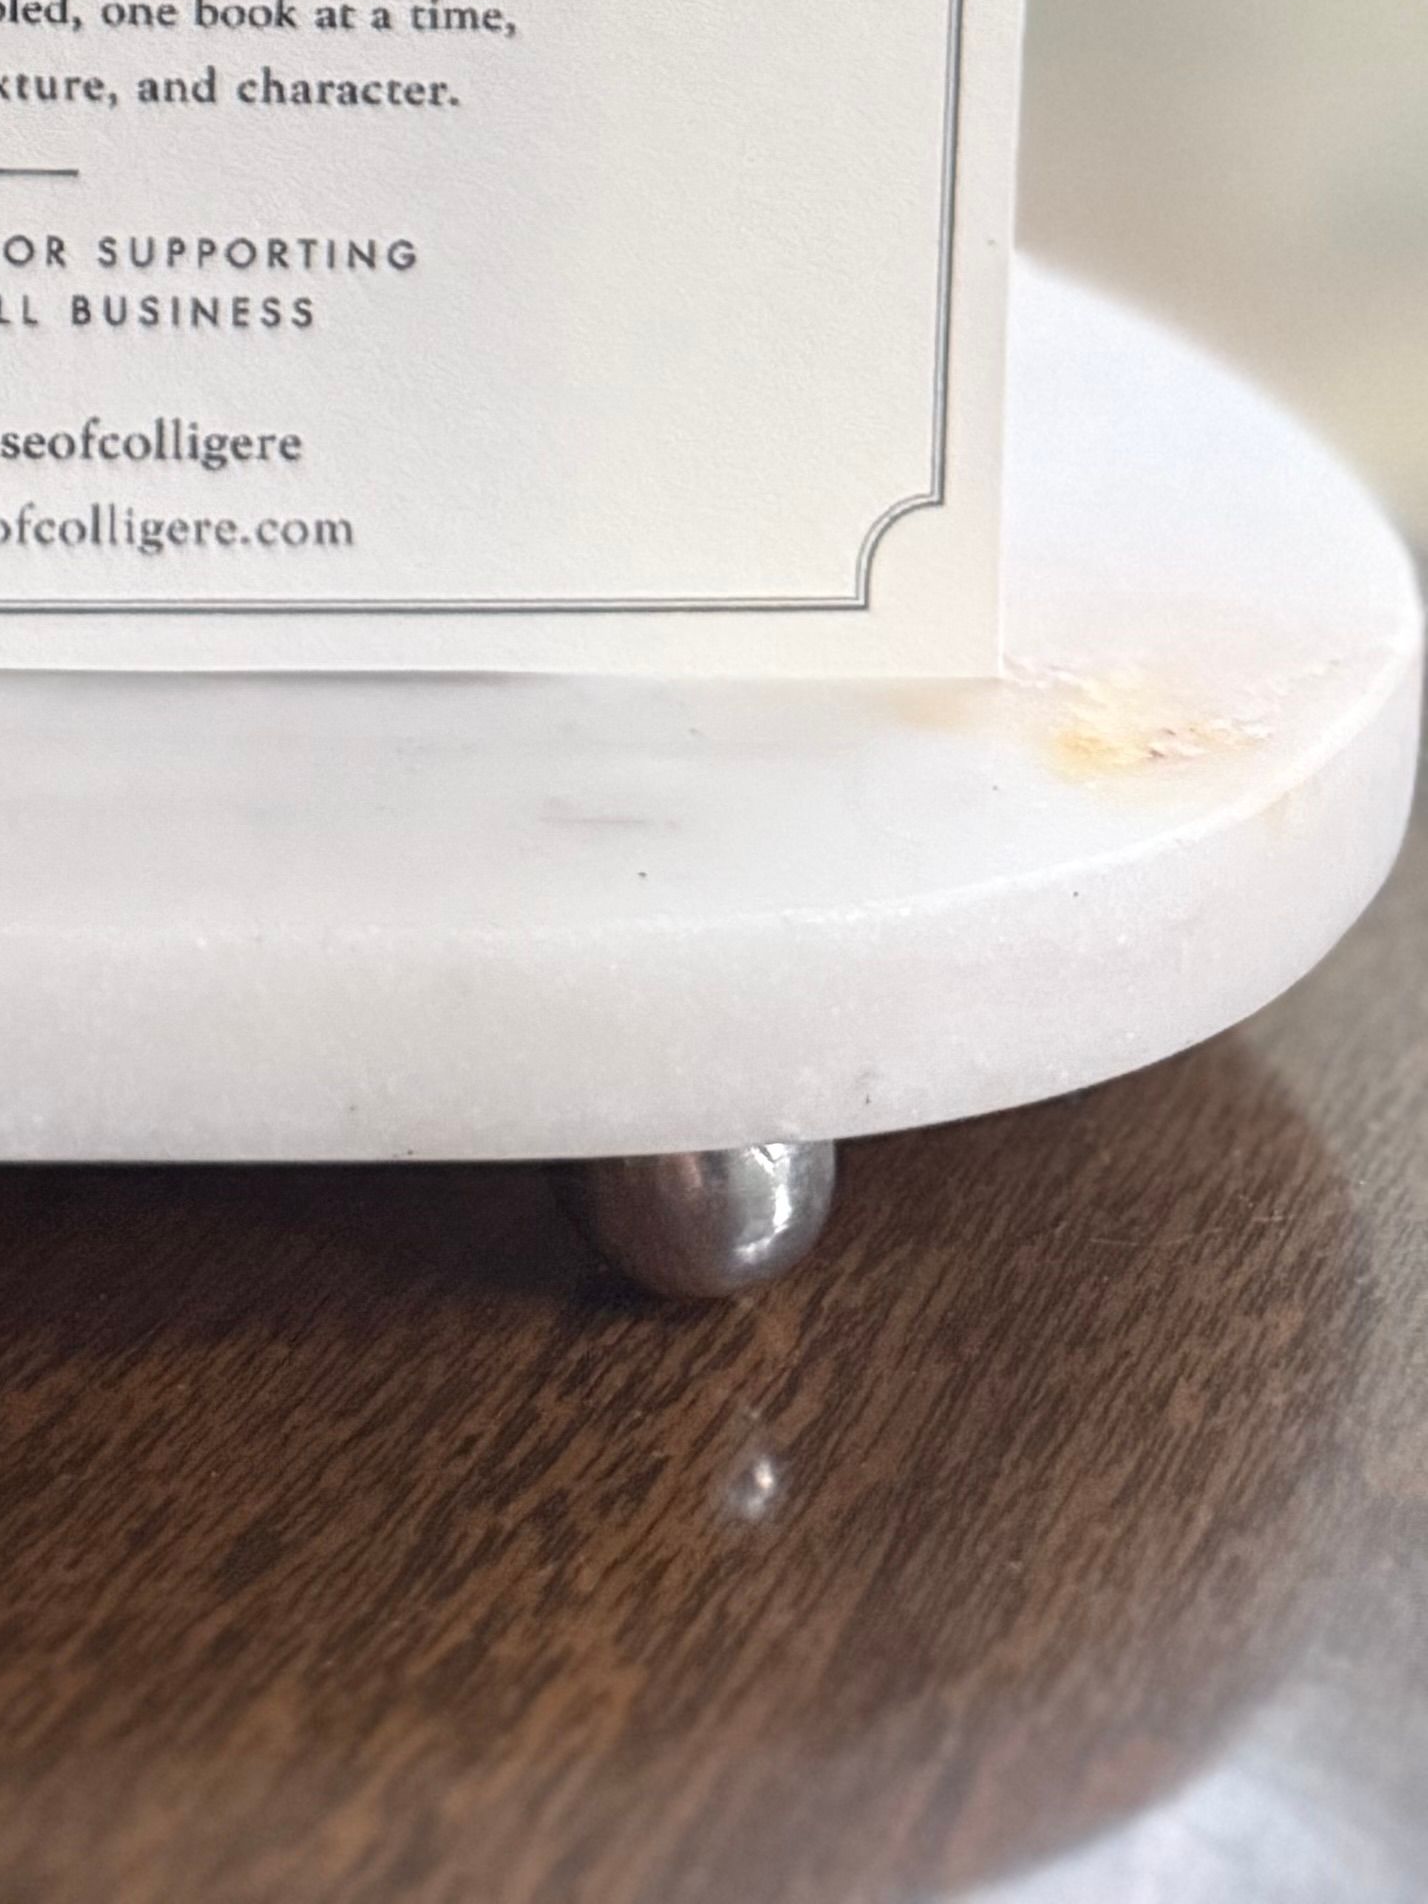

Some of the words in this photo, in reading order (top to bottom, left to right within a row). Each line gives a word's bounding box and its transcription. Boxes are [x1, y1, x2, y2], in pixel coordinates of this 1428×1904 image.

[100, 2, 178, 28] one
[314, 0, 355, 31] at
[370, 7, 393, 31] a
[137, 65, 218, 105] and
[236, 66, 460, 109] character.
[97, 235, 420, 273] SUPPORTING
[70, 293, 316, 330] BUSINESS
